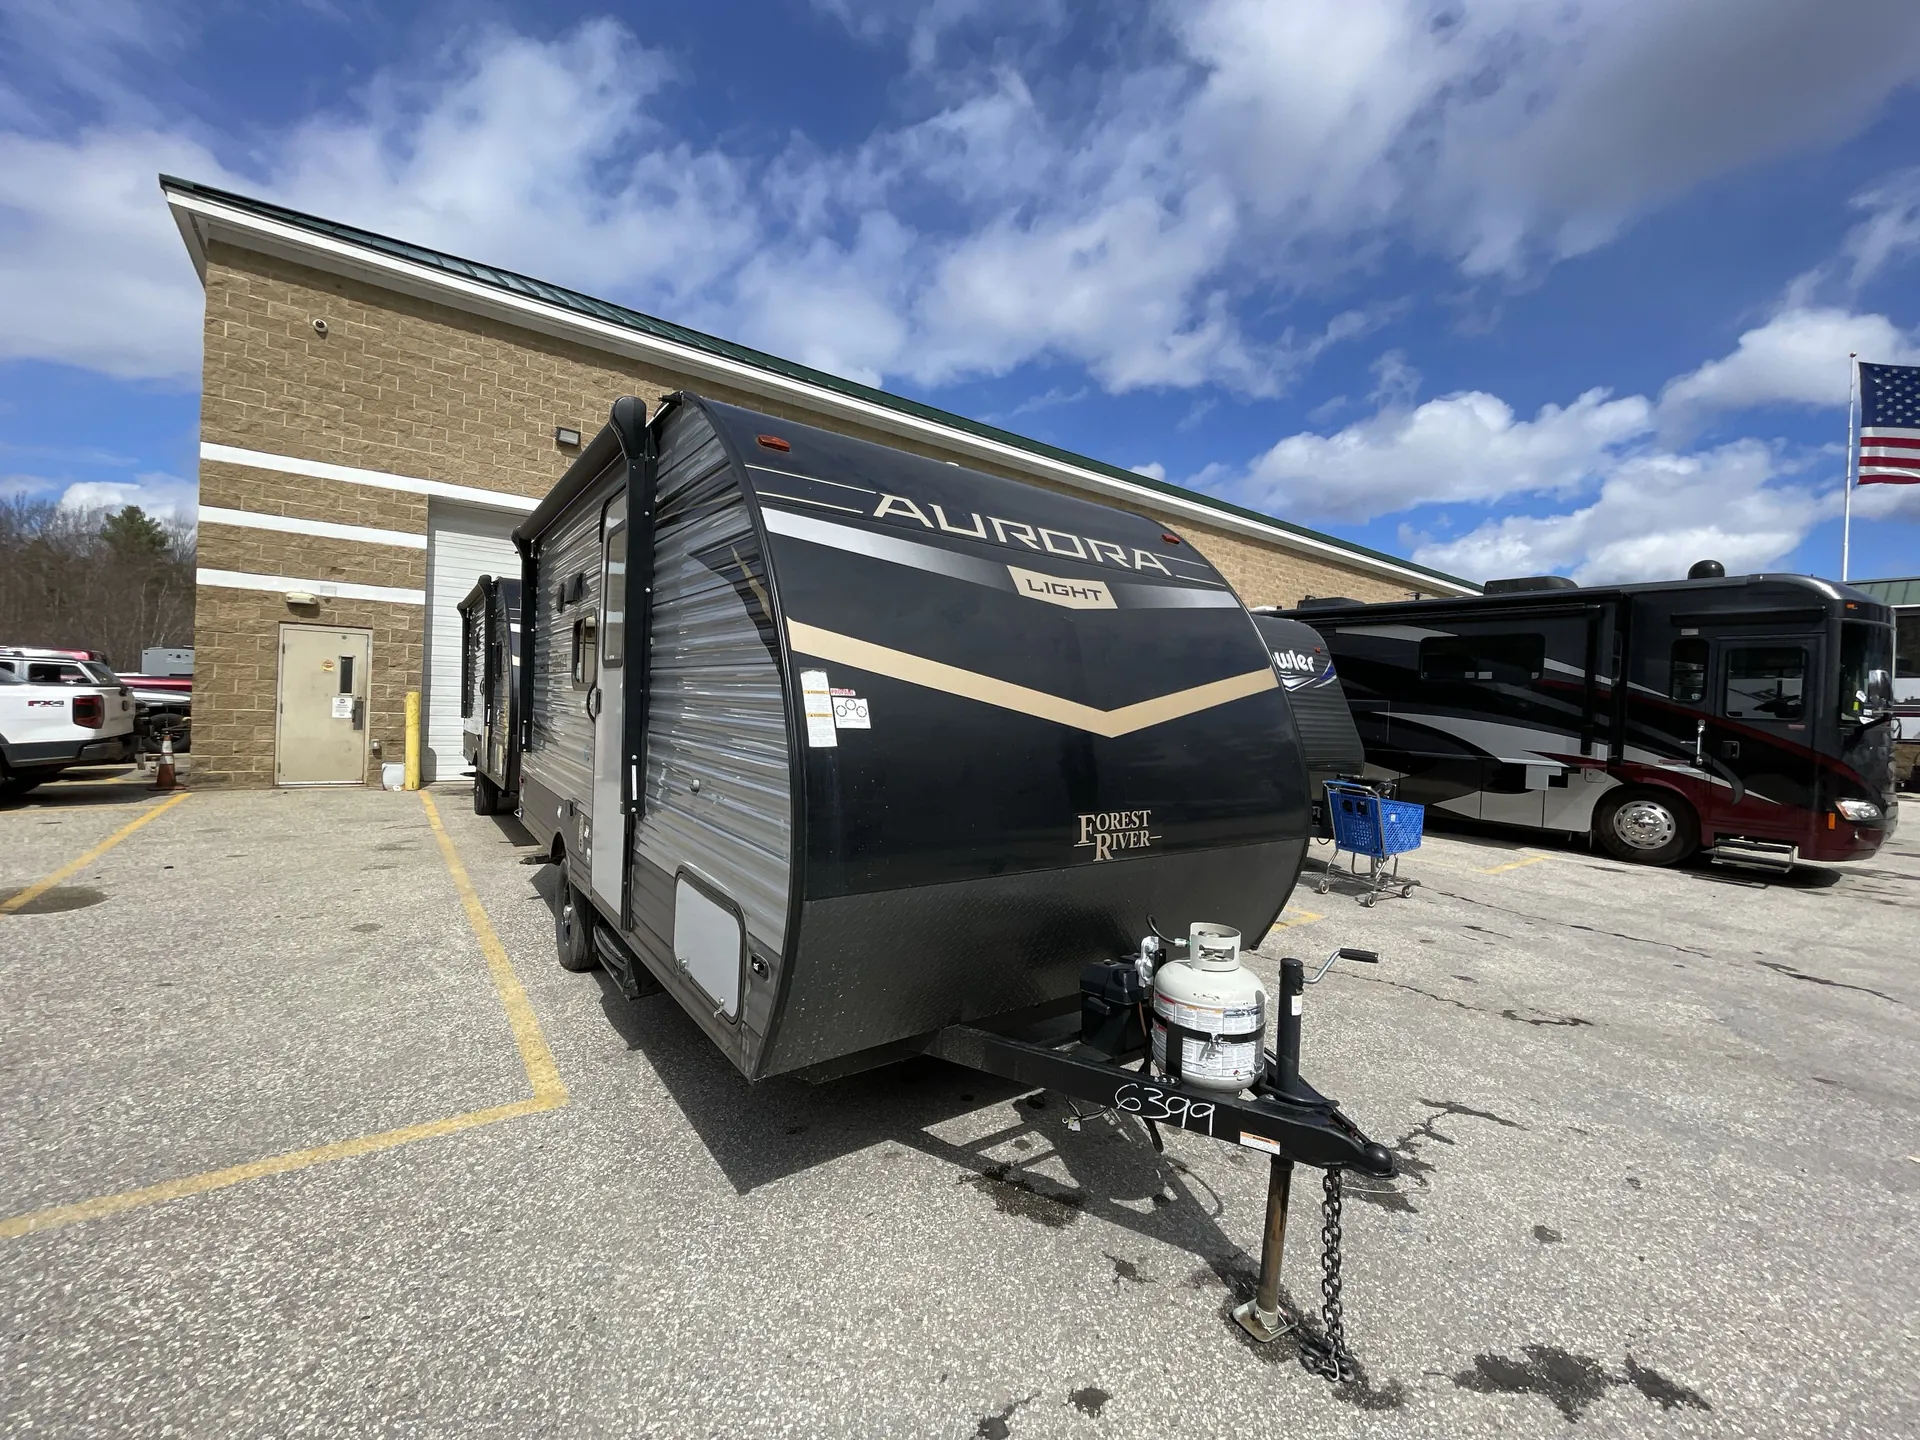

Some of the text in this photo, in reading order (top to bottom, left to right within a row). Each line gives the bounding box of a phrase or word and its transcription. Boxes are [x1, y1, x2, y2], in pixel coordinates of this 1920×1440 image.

[872, 493, 1172, 577] AURORA
[1025, 578, 1102, 602] LIGHT
[1272, 649, 1315, 673] wler
[1078, 810, 1152, 844] FOREST
[1093, 830, 1151, 862] RIVER
[1115, 1083, 1216, 1137] 6399
